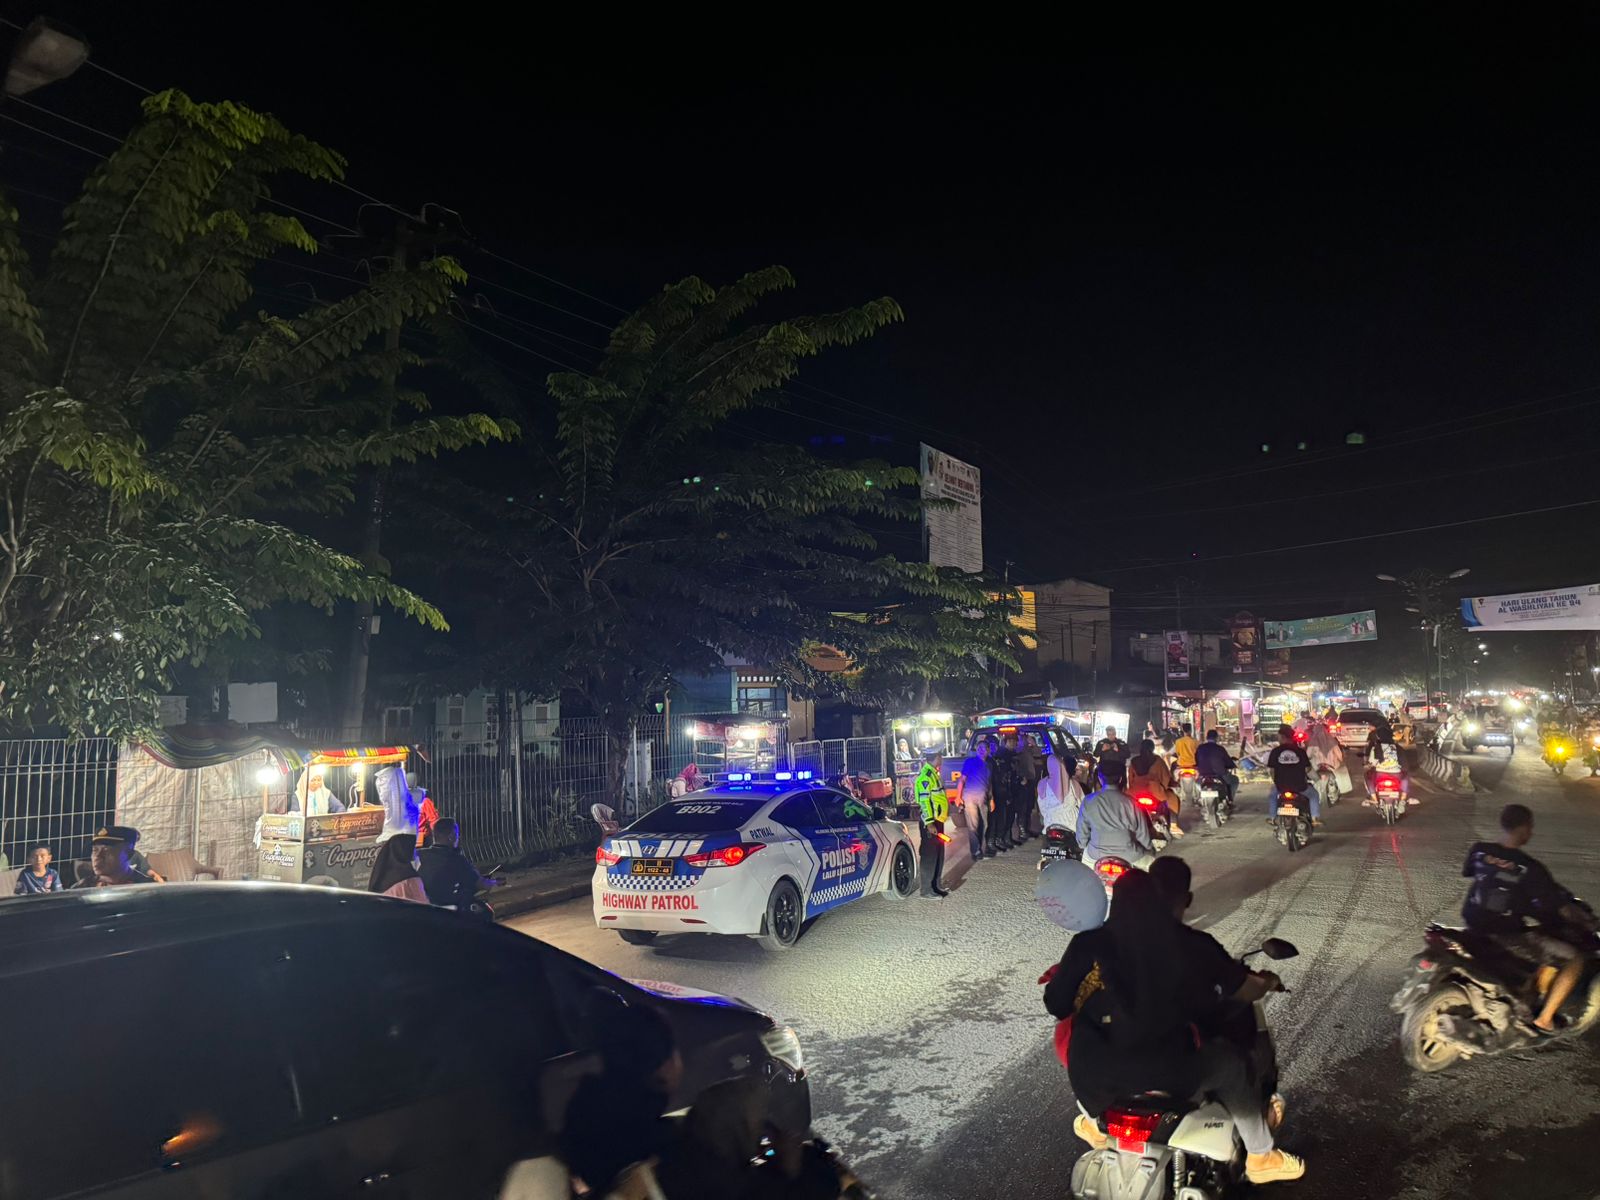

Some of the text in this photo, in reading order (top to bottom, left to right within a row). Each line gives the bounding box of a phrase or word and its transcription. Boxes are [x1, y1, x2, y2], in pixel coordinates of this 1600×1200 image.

[1500, 600, 1520, 608] HARI
[1521, 597, 1547, 605] ULANG
[1549, 594, 1577, 603] TAHUN
[1509, 602, 1555, 613] WASHLIYAH
[676, 805, 722, 815] B902
[749, 826, 775, 839] PATWAL
[821, 847, 856, 869] POLISI
[822, 864, 856, 880] LALU LANTAS
[602, 892, 699, 910] HIGHWAY PATROL
